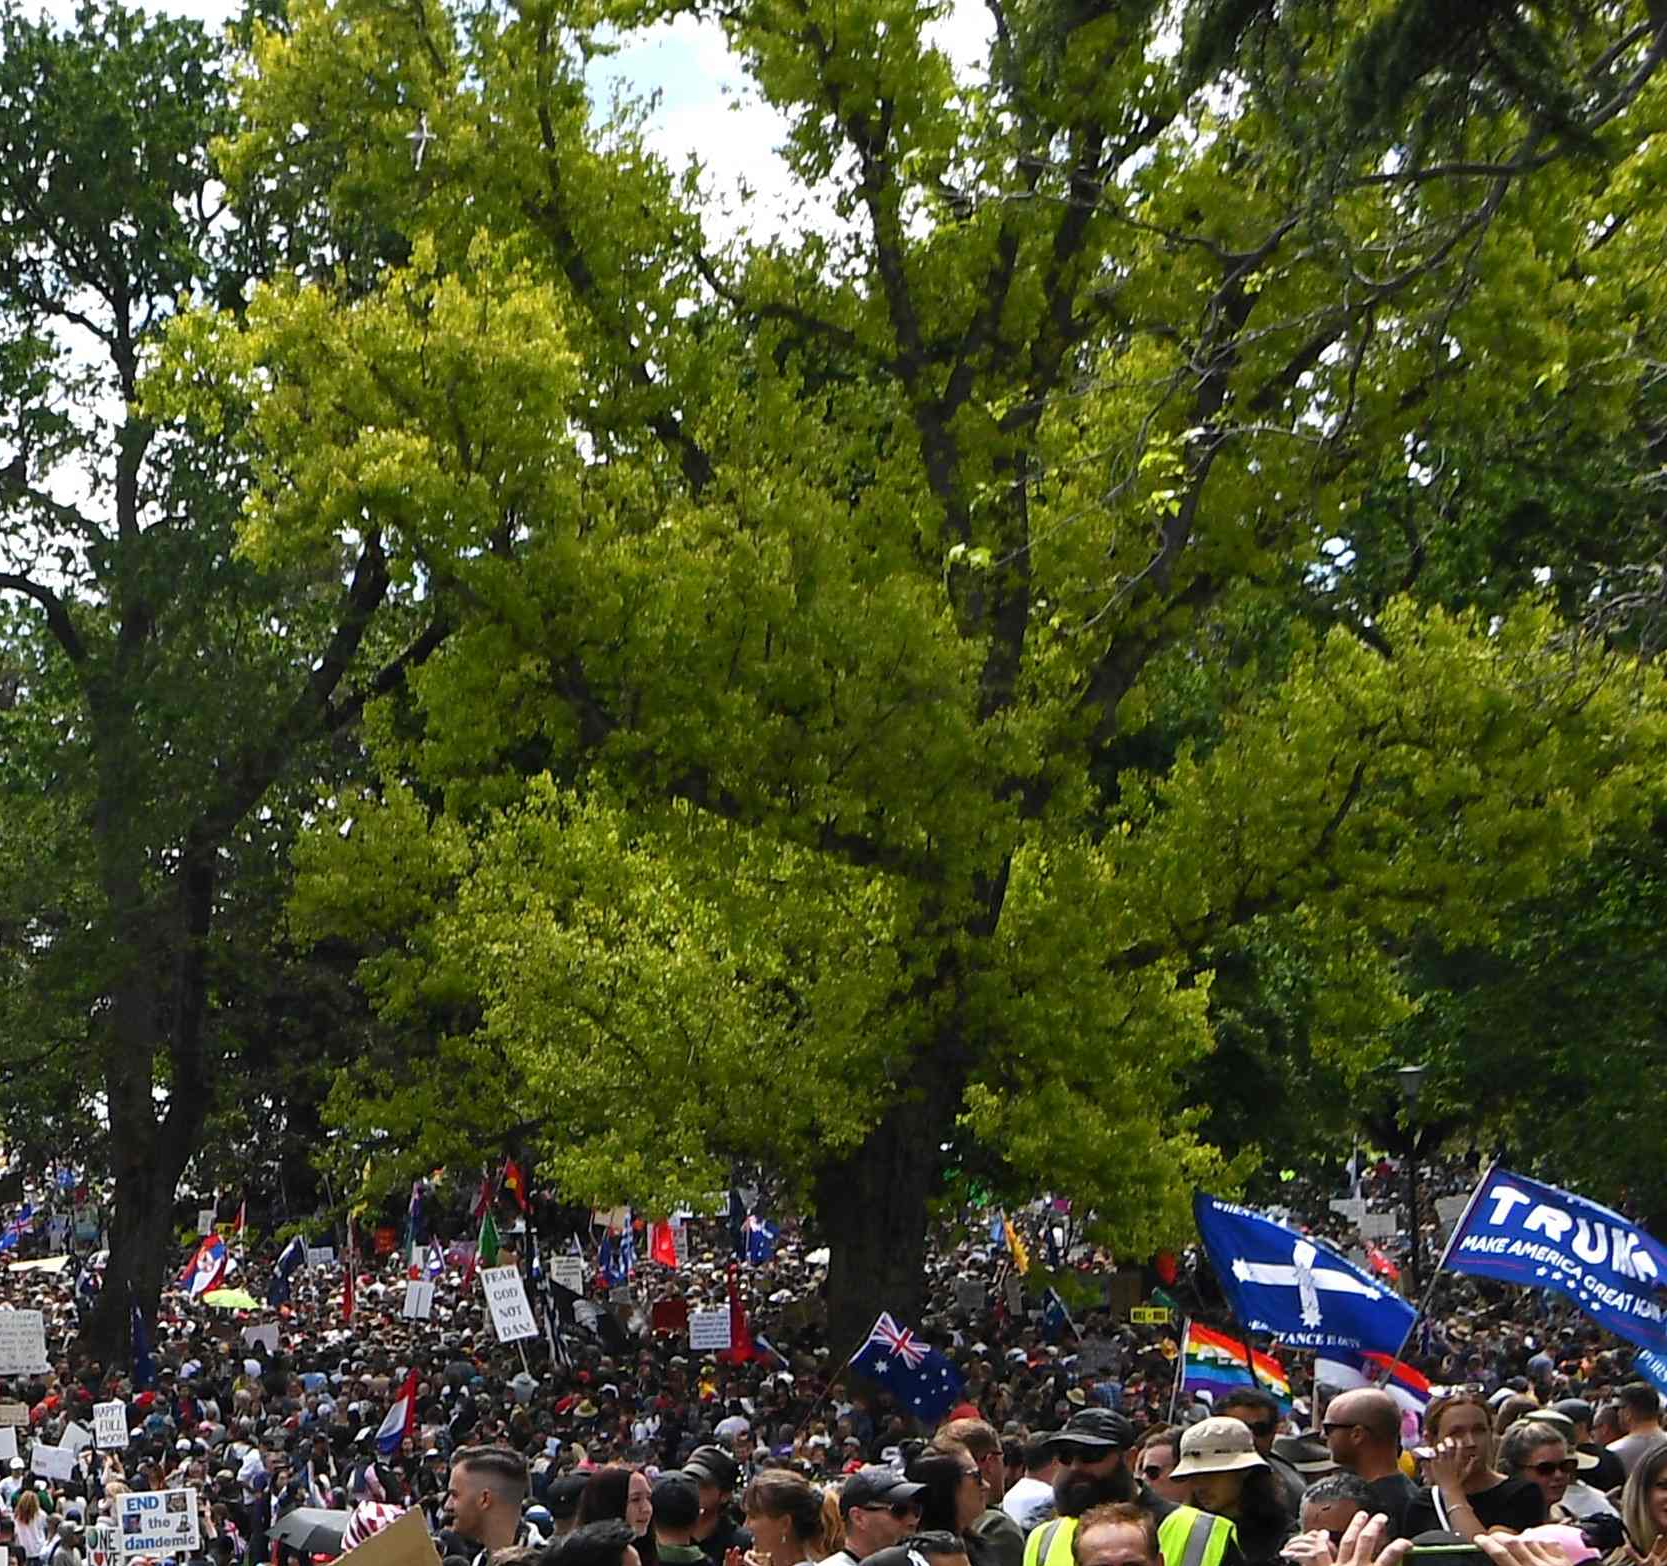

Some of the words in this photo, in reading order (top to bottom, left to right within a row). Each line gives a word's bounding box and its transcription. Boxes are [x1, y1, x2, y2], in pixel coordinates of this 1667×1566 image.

[485, 1269, 515, 1284] FEAR
[1459, 1235, 1510, 1253] MAKE
[1507, 1239, 1583, 1280] AMERICA
[1583, 1276, 1631, 1312] GREAT
[493, 1288, 518, 1300] GOD
[499, 1305, 522, 1317] NOT
[502, 1322, 530, 1337] DAN!
[94, 1404, 123, 1417] HAPPY
[100, 1420, 123, 1431] FULL
[99, 1433, 125, 1442] MOON
[126, 1496, 159, 1511] END
[148, 1516, 170, 1529] the
[125, 1534, 195, 1550] dandemic
